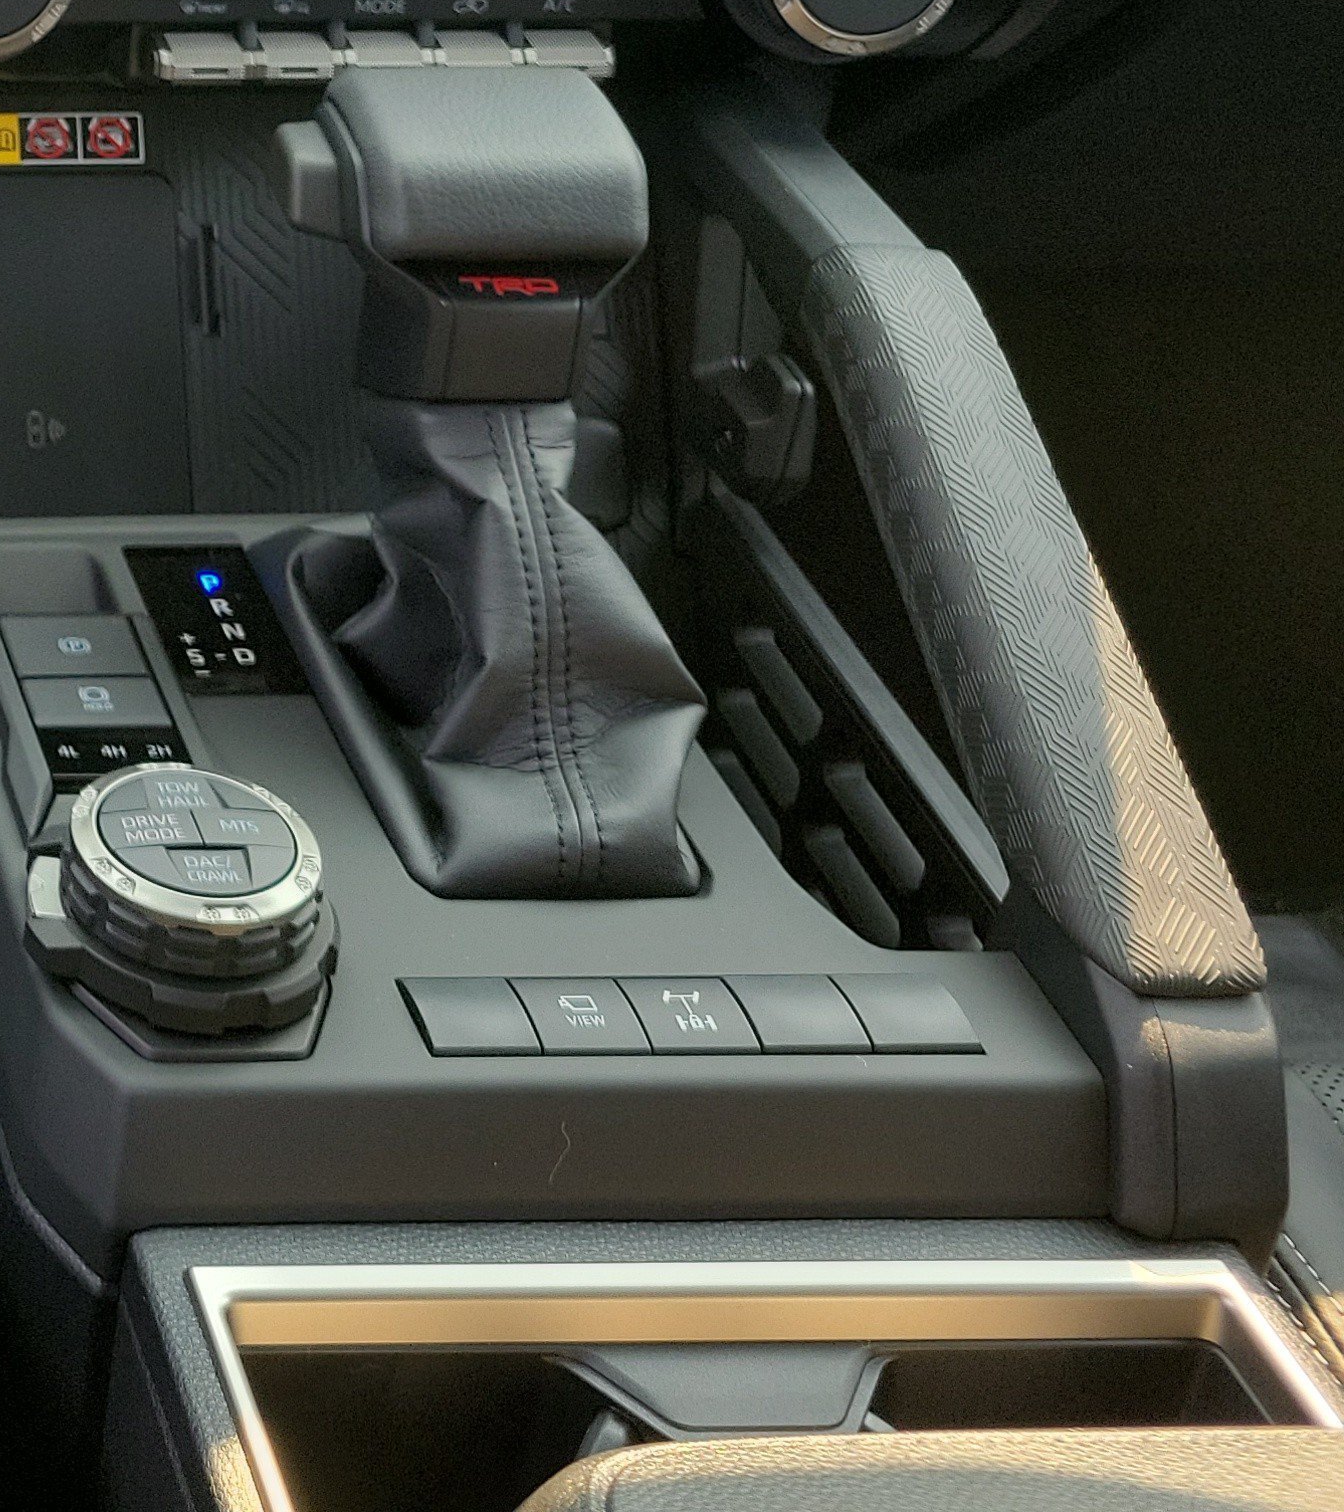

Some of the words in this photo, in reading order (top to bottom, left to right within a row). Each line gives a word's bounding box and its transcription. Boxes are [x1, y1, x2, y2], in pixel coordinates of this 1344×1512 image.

[459, 275, 559, 296] TRD
[199, 573, 220, 593] P
[210, 598, 234, 617] R
[221, 623, 247, 641] N
[185, 648, 206, 666] S
[232, 647, 256, 666] D
[57, 744, 80, 759] 4L
[100, 744, 128, 759] 4H
[145, 743, 173, 759] 2H
[158, 781, 199, 794] TOW
[158, 795, 210, 809] HAUL
[121, 813, 179, 829] DRIVE
[219, 819, 259, 833] MTS
[125, 828, 186, 845] MODE
[187, 870, 241, 883] CRAWL
[565, 1015, 605, 1028] VIEW
